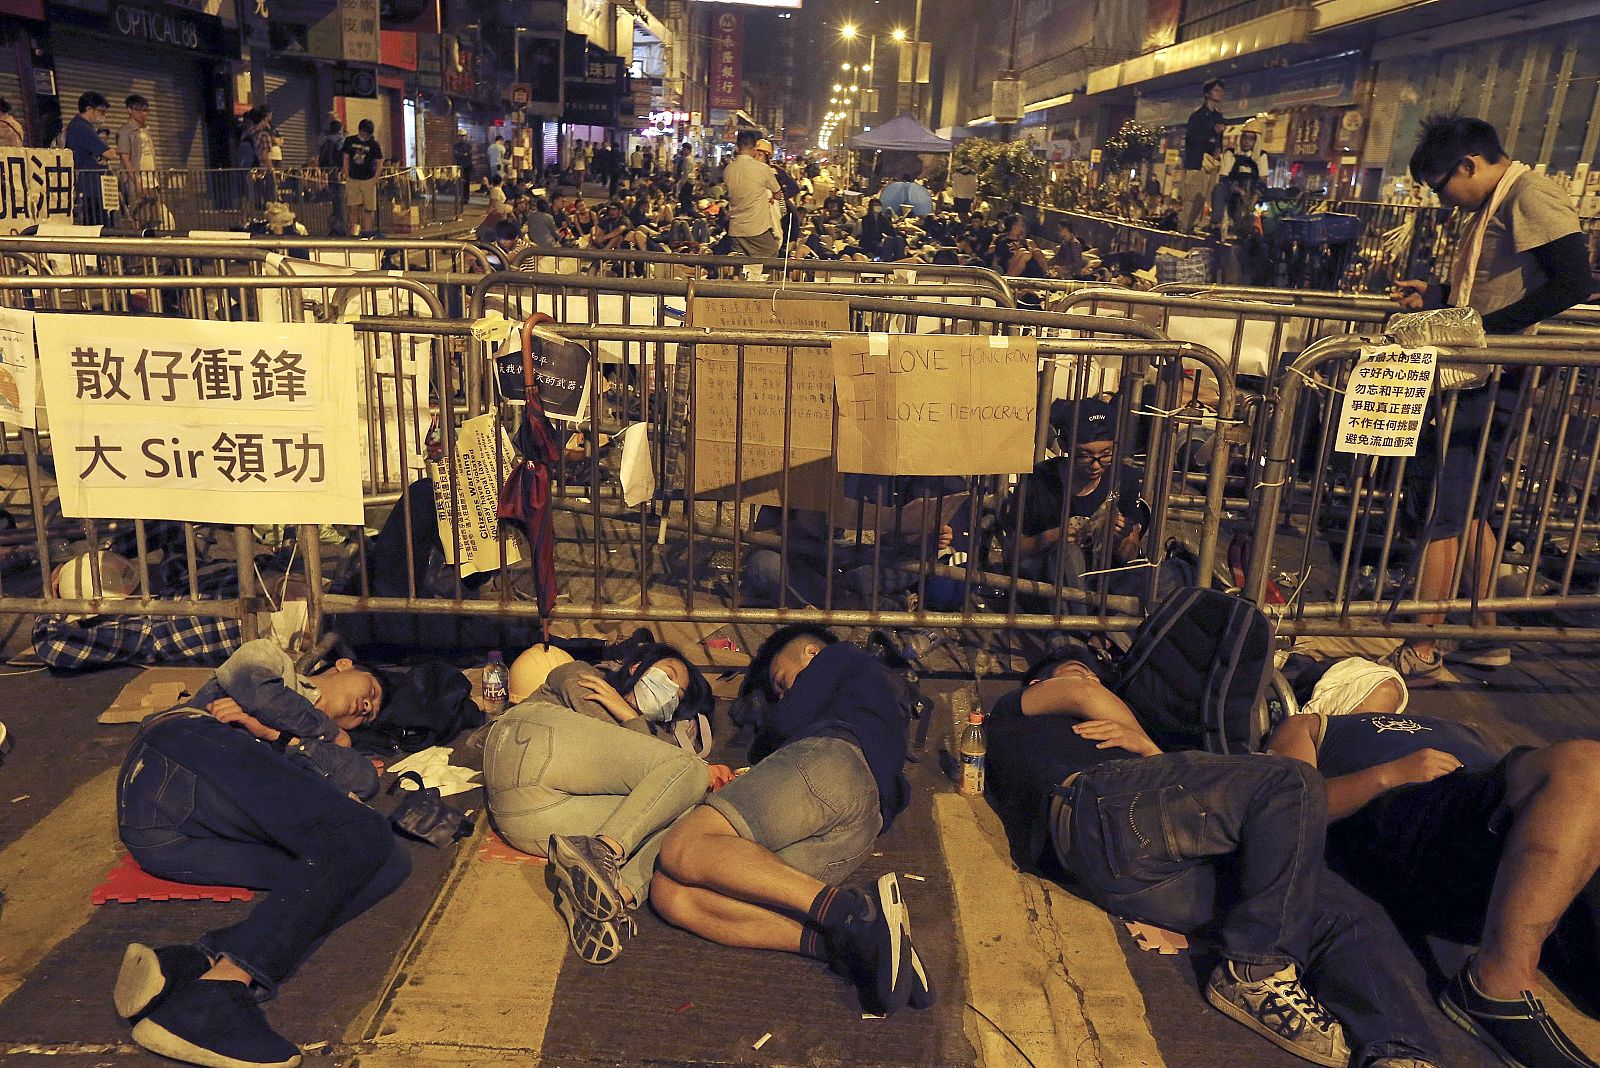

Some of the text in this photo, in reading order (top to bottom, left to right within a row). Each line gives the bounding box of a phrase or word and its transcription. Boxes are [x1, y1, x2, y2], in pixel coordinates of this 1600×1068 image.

[116, 4, 198, 49] OPTICAL 88
[851, 352, 875, 376] I
[888, 350, 948, 374] LOVE
[71, 347, 307, 402] 散仔衝鋒
[1355, 384, 1427, 398] 勿忘和平初衷
[851, 400, 875, 422] I
[950, 403, 1035, 423] DEMOCRACY
[1088, 414, 1106, 422] CREW
[1351, 400, 1422, 415] 爭取真正普選
[1344, 433, 1415, 448] 避免流血衝突
[462, 453, 477, 497] Warning
[468, 449, 480, 484] violated
[477, 460, 485, 475] law
[477, 486, 487, 505] have
[474, 499, 489, 540] Citizens
[483, 507, 494, 524] may
